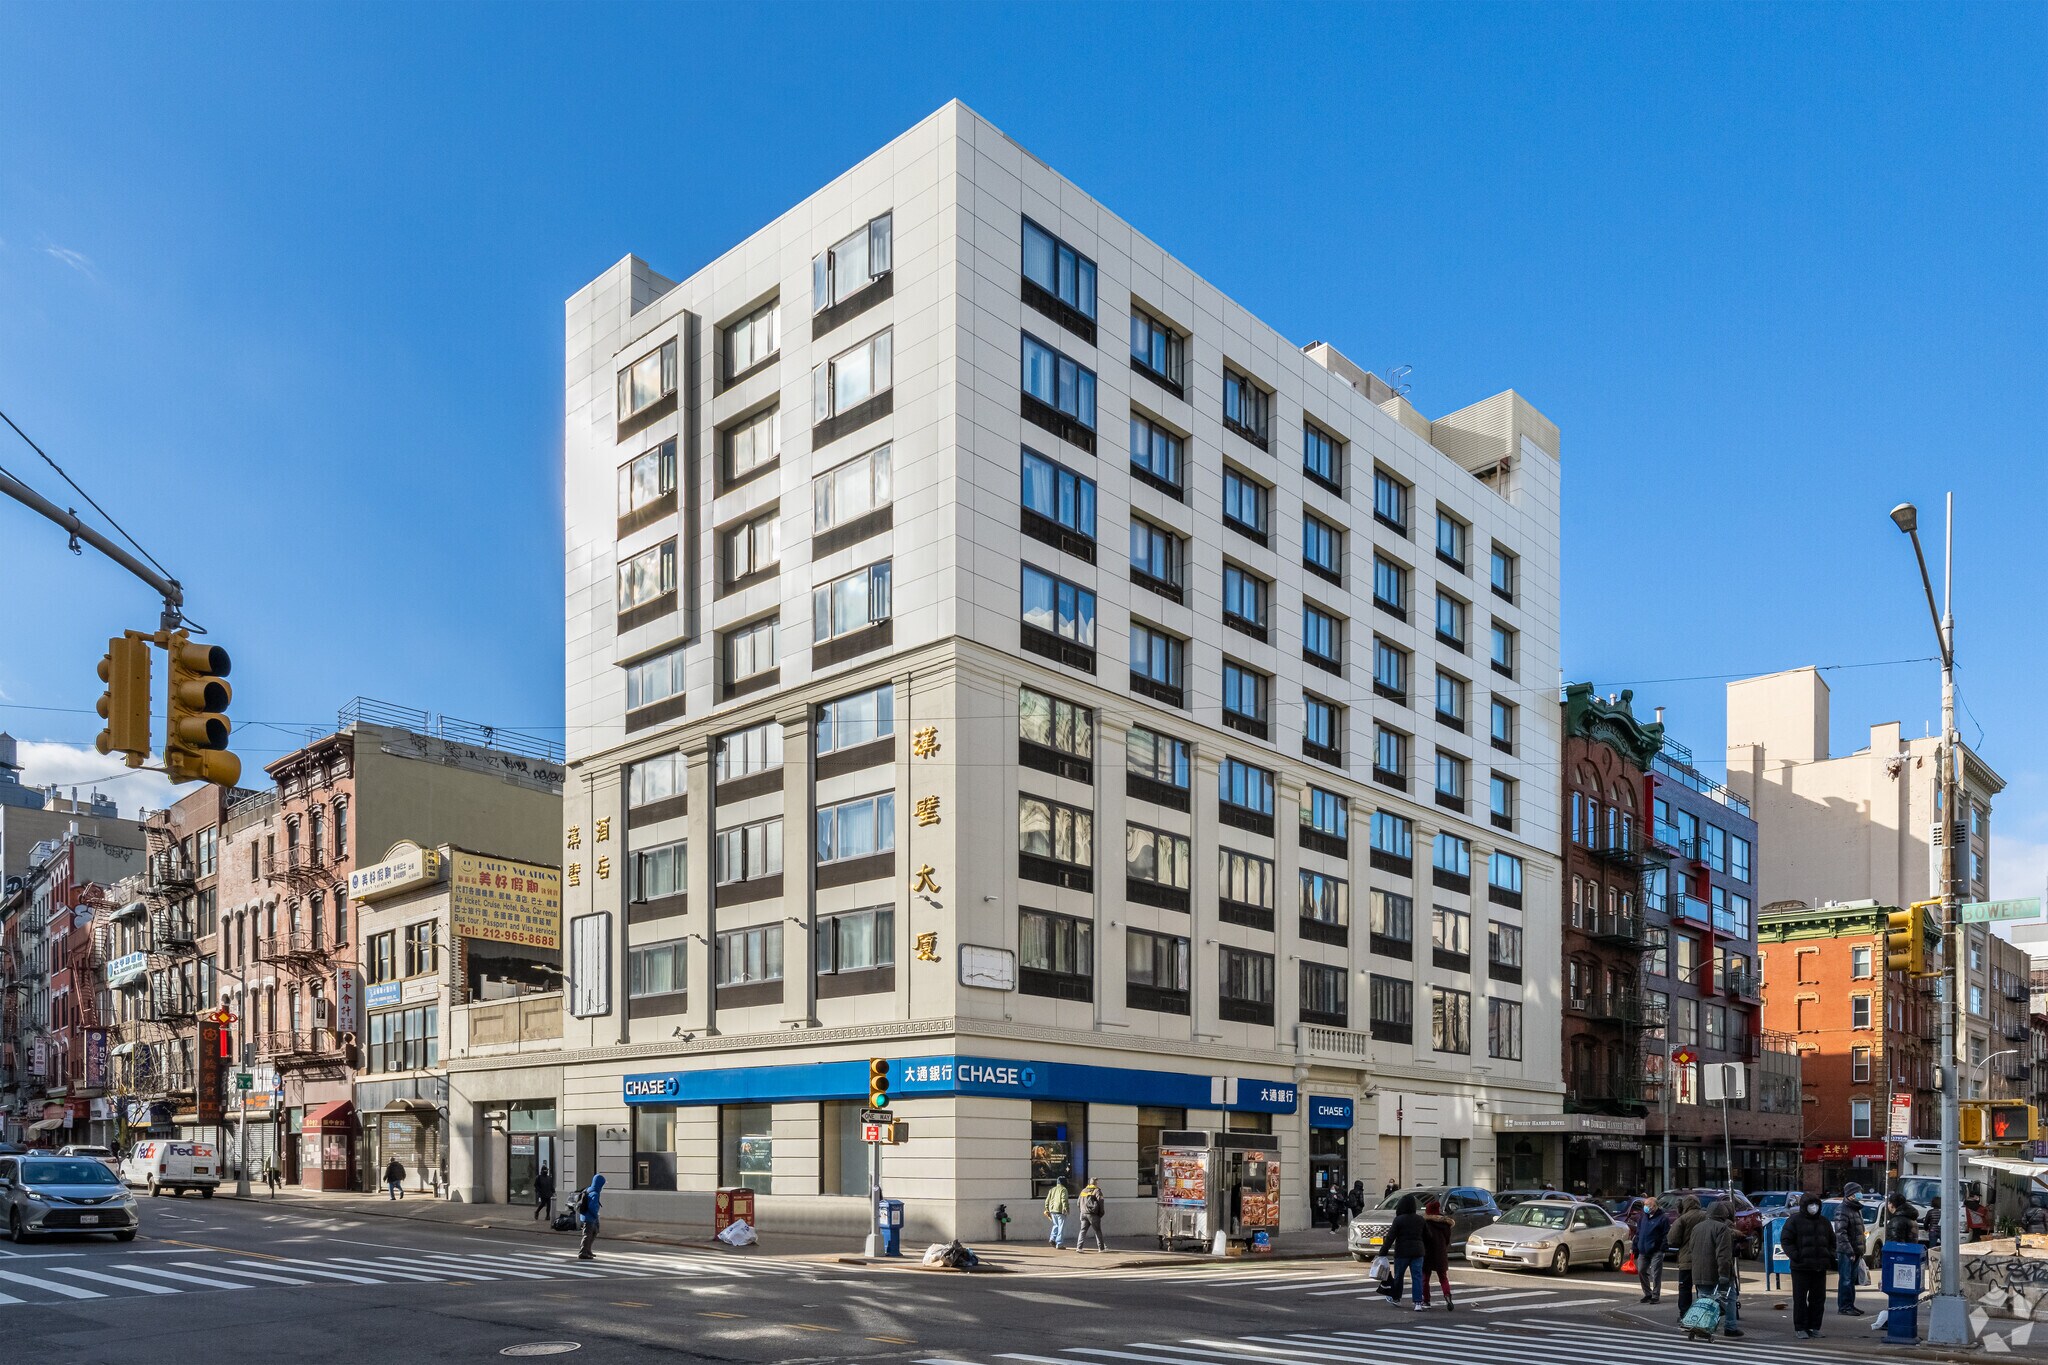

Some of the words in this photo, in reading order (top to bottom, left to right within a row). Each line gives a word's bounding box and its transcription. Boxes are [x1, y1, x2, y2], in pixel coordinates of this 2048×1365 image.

[596, 815, 611, 880] 酒店
[479, 871, 539, 893] 美好假期
[454, 895, 463, 903] Air
[533, 907, 542, 915] Car
[543, 909, 558, 918] rental
[1963, 901, 2034, 920] BOWERY
[454, 914, 465, 923] Bus
[483, 918, 508, 930] Passport
[509, 922, 520, 931] and
[521, 924, 533, 933] Visa
[535, 927, 557, 937] services
[459, 924, 479, 936] Tel:
[905, 1064, 953, 1083] 大通銀行
[957, 1064, 1019, 1085] CHASE
[625, 1079, 666, 1095] CHASE
[1260, 1088, 1294, 1103] 大通銀行
[1318, 1105, 1344, 1116] CHASE
[137, 1142, 157, 1160] FedEx
[170, 1144, 212, 1157] FedEx
[1823, 1144, 1849, 1154] 王老吉
